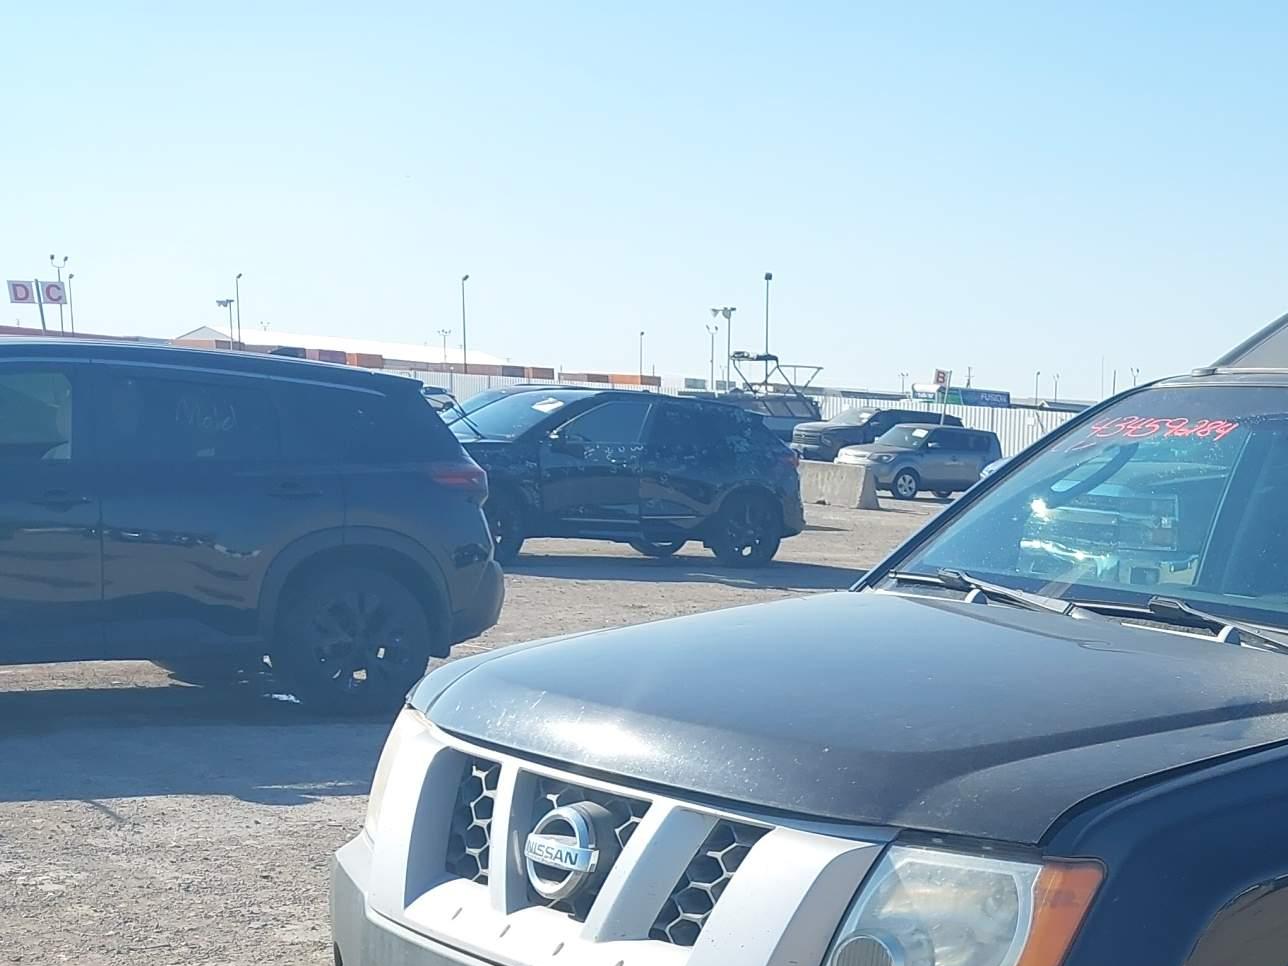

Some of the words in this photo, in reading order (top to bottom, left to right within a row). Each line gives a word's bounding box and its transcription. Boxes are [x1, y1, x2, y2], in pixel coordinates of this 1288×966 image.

[12, 284, 29, 301] D
[46, 284, 62, 302] C
[936, 370, 946, 384] B
[526, 839, 579, 866] NISSAN
